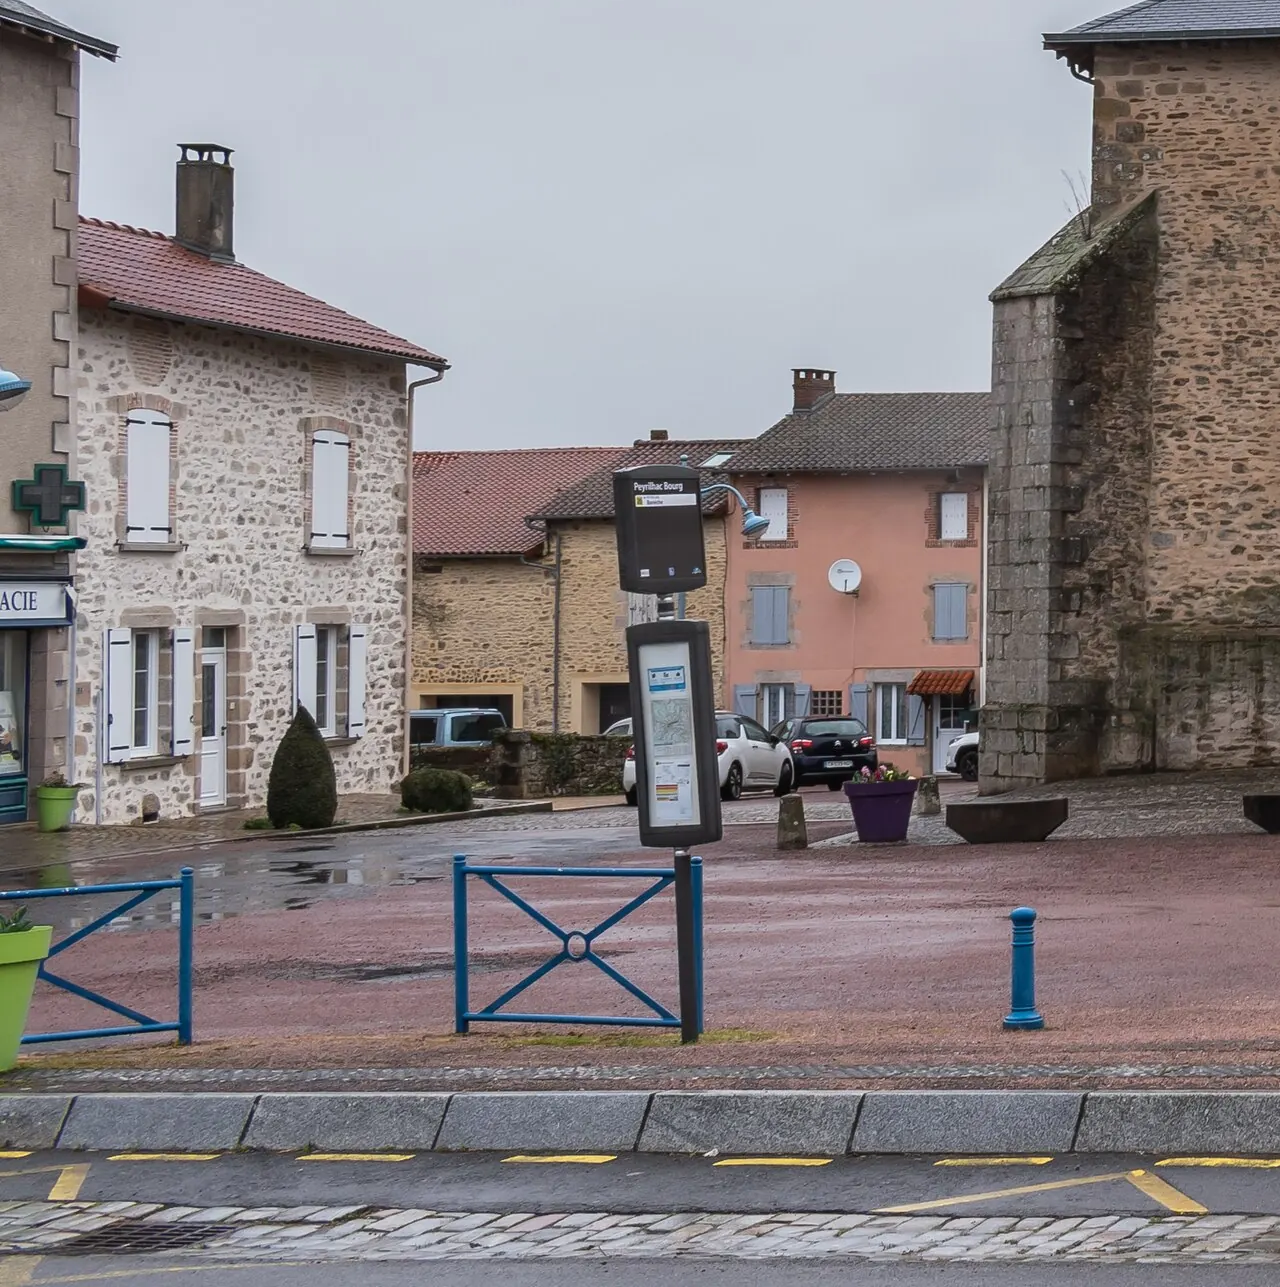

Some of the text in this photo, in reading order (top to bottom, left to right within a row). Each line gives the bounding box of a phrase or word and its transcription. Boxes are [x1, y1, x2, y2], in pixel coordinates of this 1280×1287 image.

[633, 481, 683, 493] Peyrilhac Bourg
[0, 590, 38, 611] ACIE
